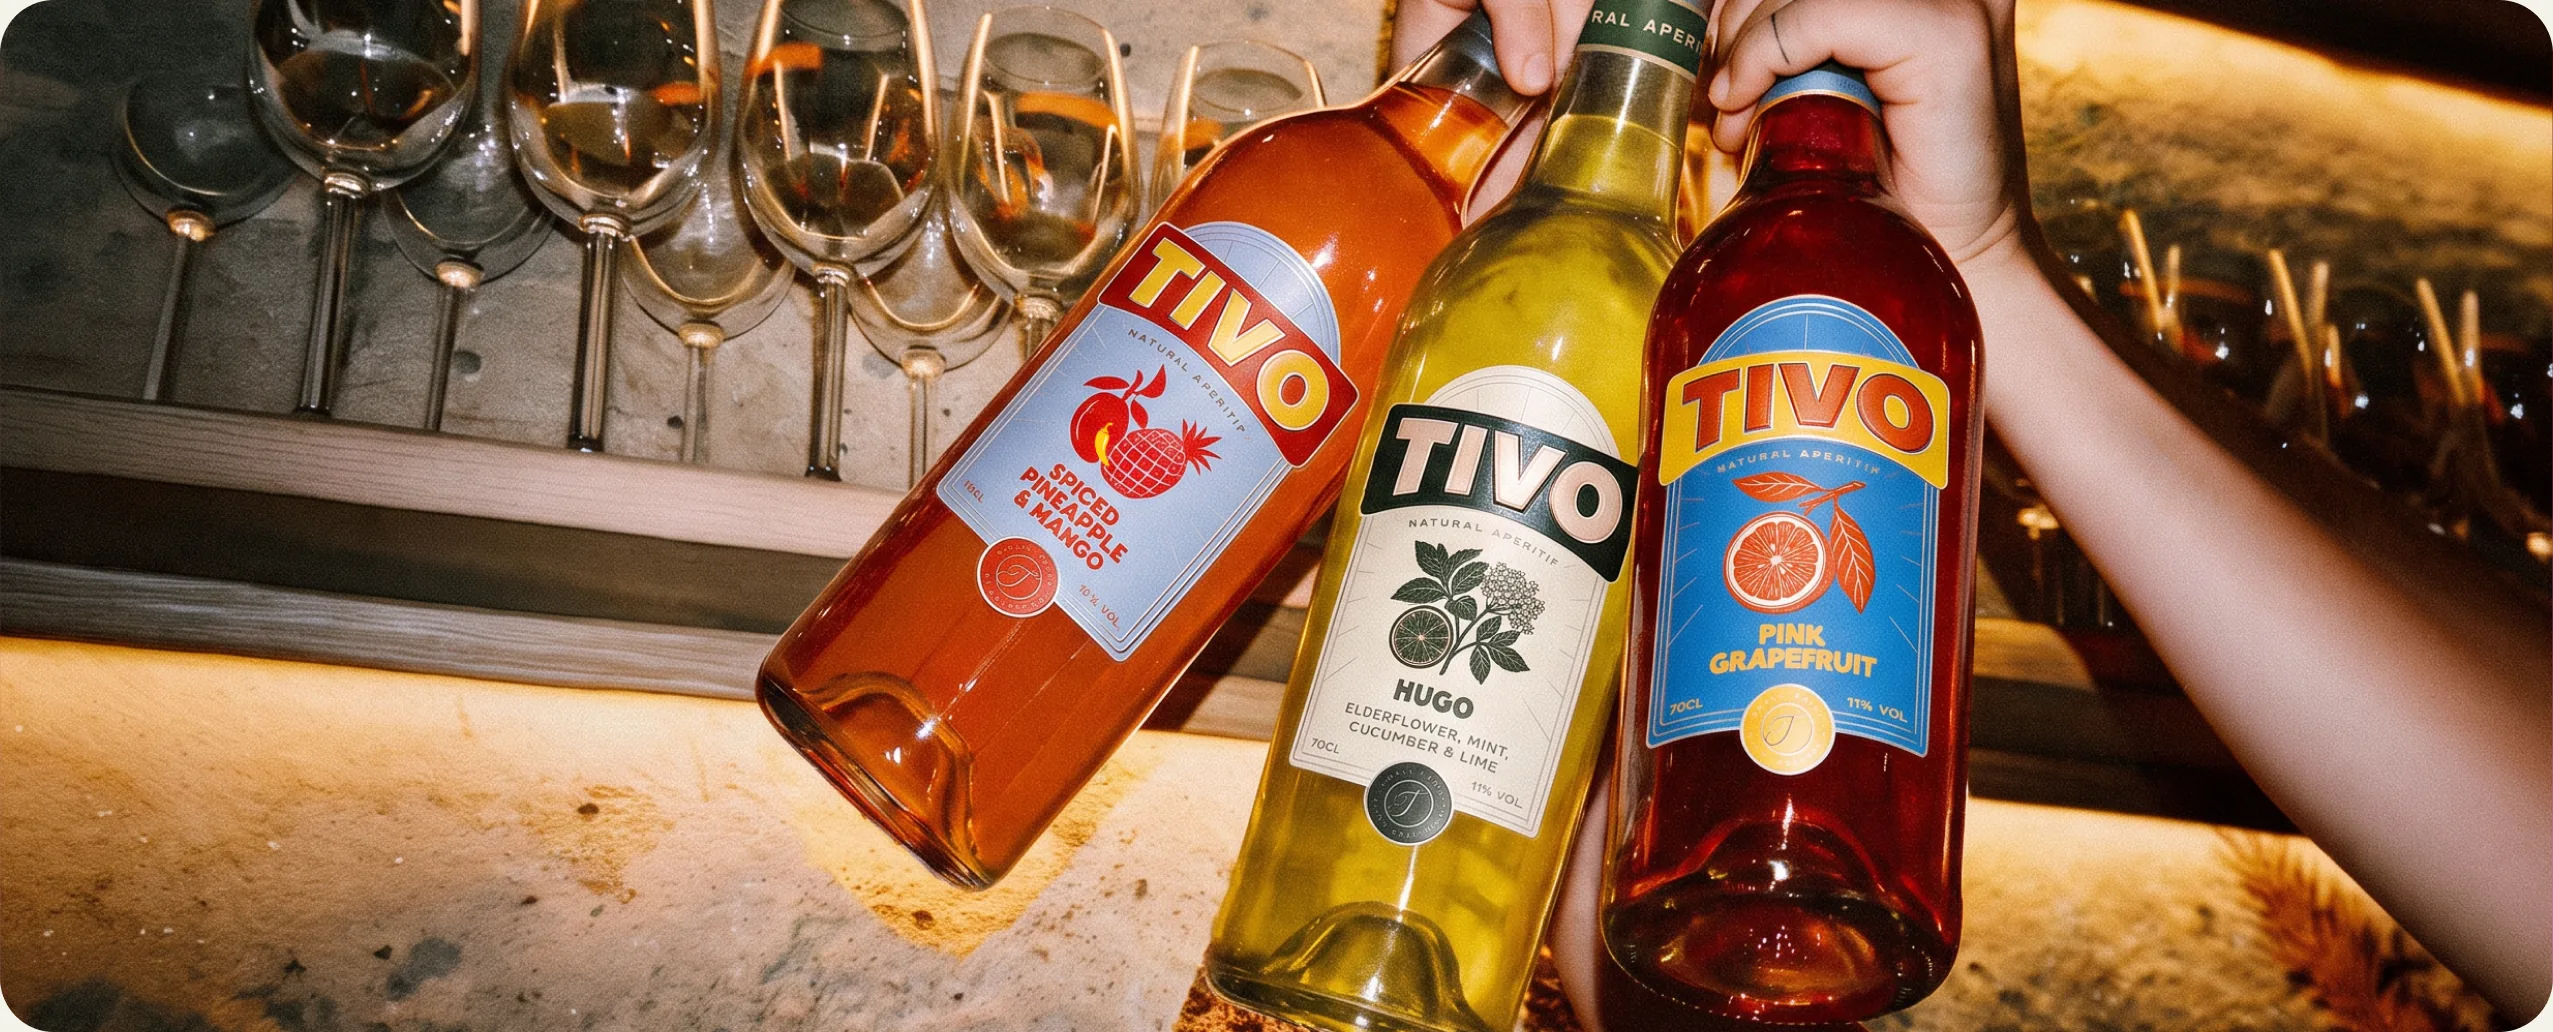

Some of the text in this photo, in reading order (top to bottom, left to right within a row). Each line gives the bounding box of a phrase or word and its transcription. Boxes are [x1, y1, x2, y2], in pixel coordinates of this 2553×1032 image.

[1128, 329, 1188, 372] NATURAL
[1129, 237, 1330, 431] TIVO
[1682, 362, 1935, 454] TIVO
[1049, 463, 1119, 526] SPICED
[1392, 417, 1623, 544] TIVO
[1014, 490, 1103, 570] & MANGO
[1020, 466, 1128, 563] PINEAPPLE
[1408, 518, 1559, 566] NATURAL APERITIF
[1758, 623, 1826, 647] PINK
[1709, 647, 1877, 678] GRAPEFRUIT
[1393, 678, 1474, 719] HUGO
[1669, 698, 1703, 716] 70CL
[1847, 697, 1908, 724] 11% VOL
[1310, 738, 1340, 755] 70CL
[1345, 702, 1509, 761] ELDERFLOWER, MINT,
[1349, 721, 1499, 774] CUCUMBER & LIME
[1471, 781, 1523, 809] 11% VOL
